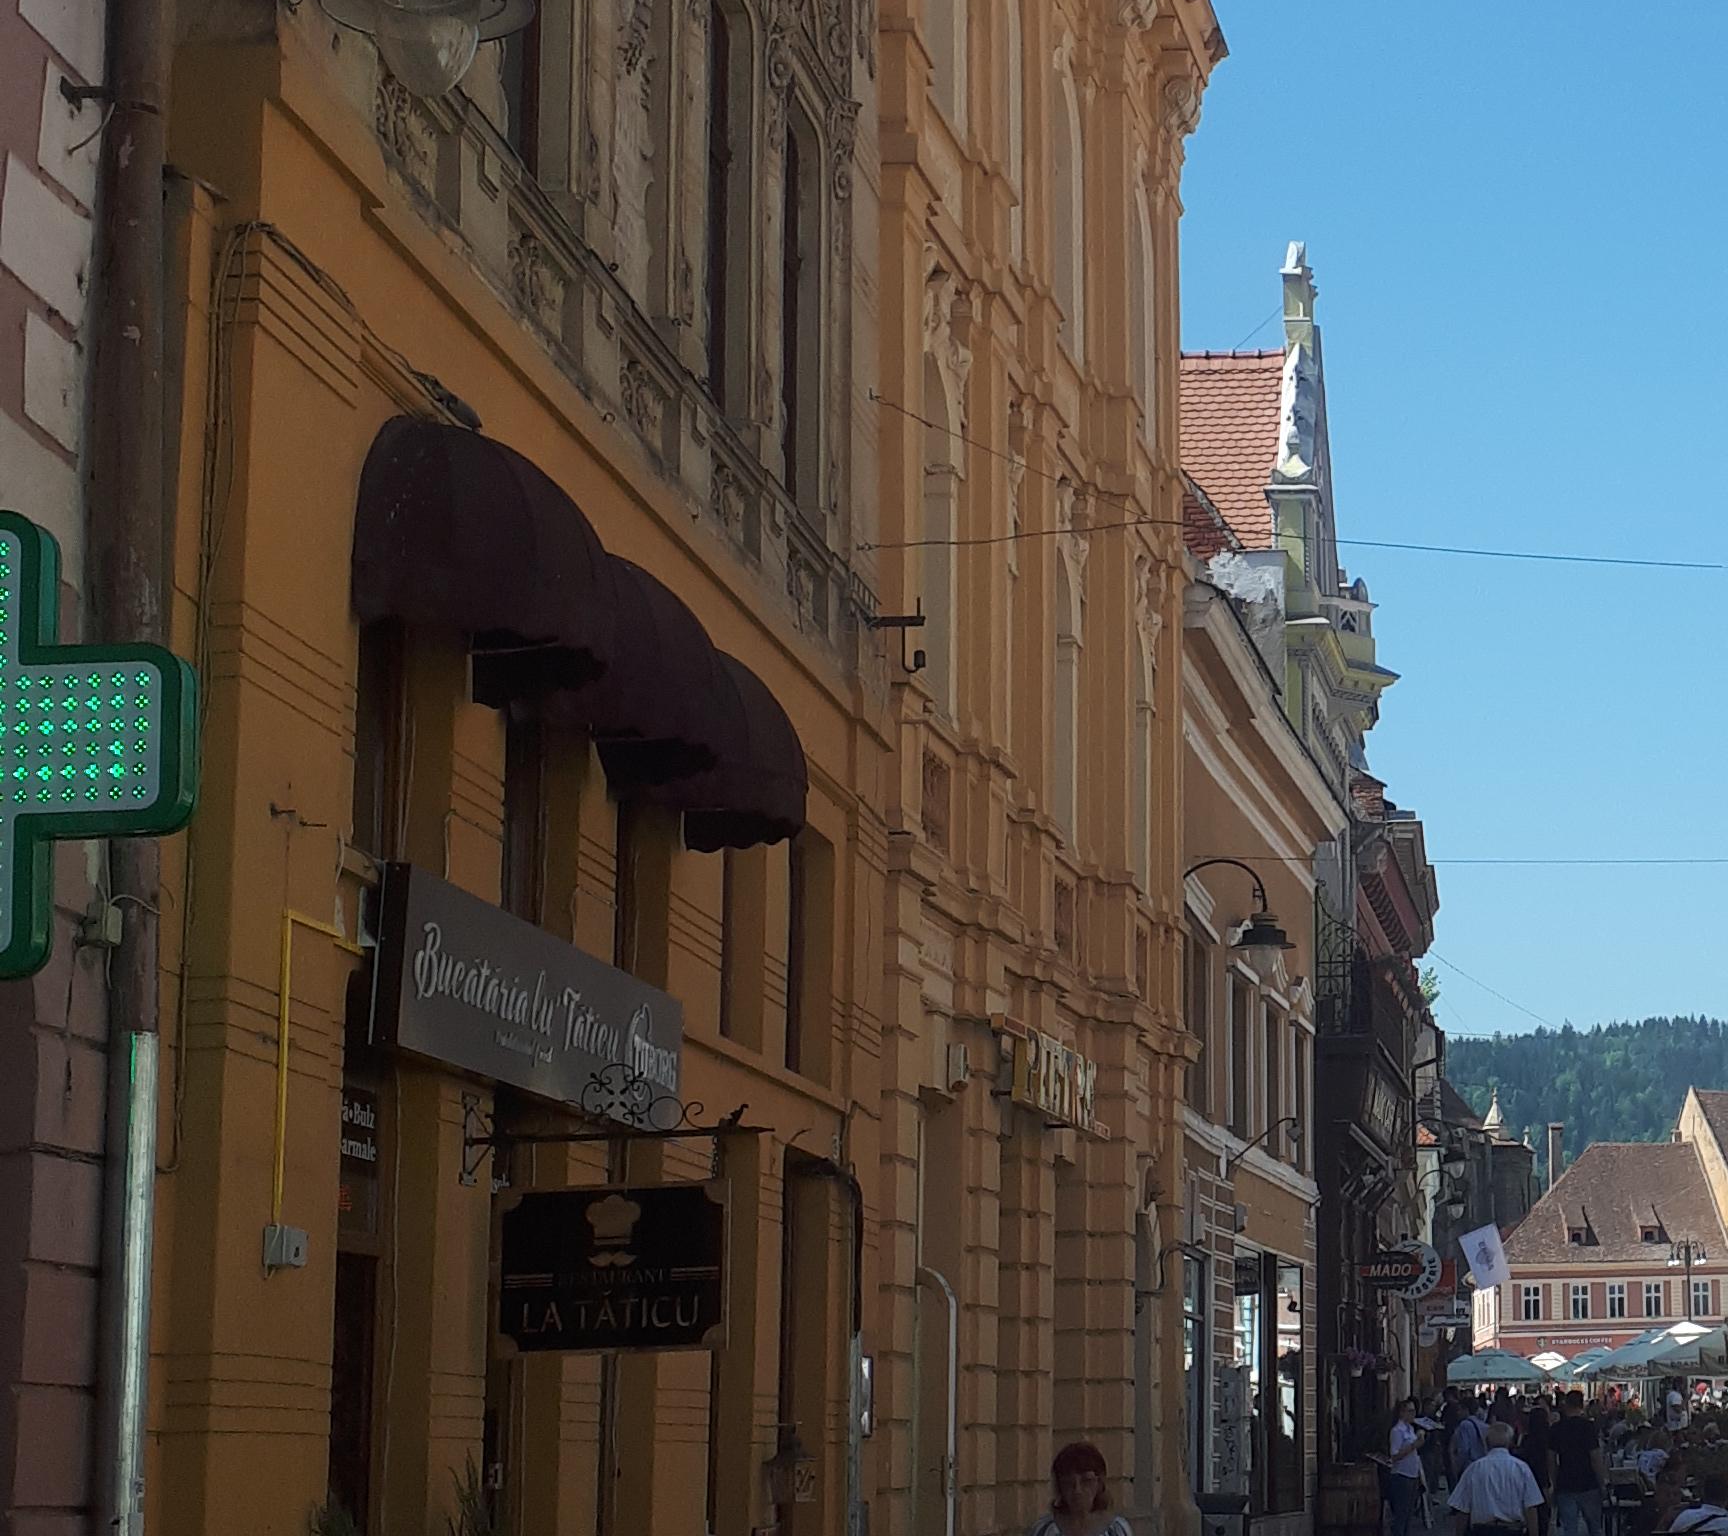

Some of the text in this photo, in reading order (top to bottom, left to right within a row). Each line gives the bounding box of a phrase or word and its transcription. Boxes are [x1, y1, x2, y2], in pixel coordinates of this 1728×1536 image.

[341, 1137, 377, 1162] armale
[1369, 1264, 1412, 1277] MADO
[520, 1289, 700, 1332] LA TĂTICU
